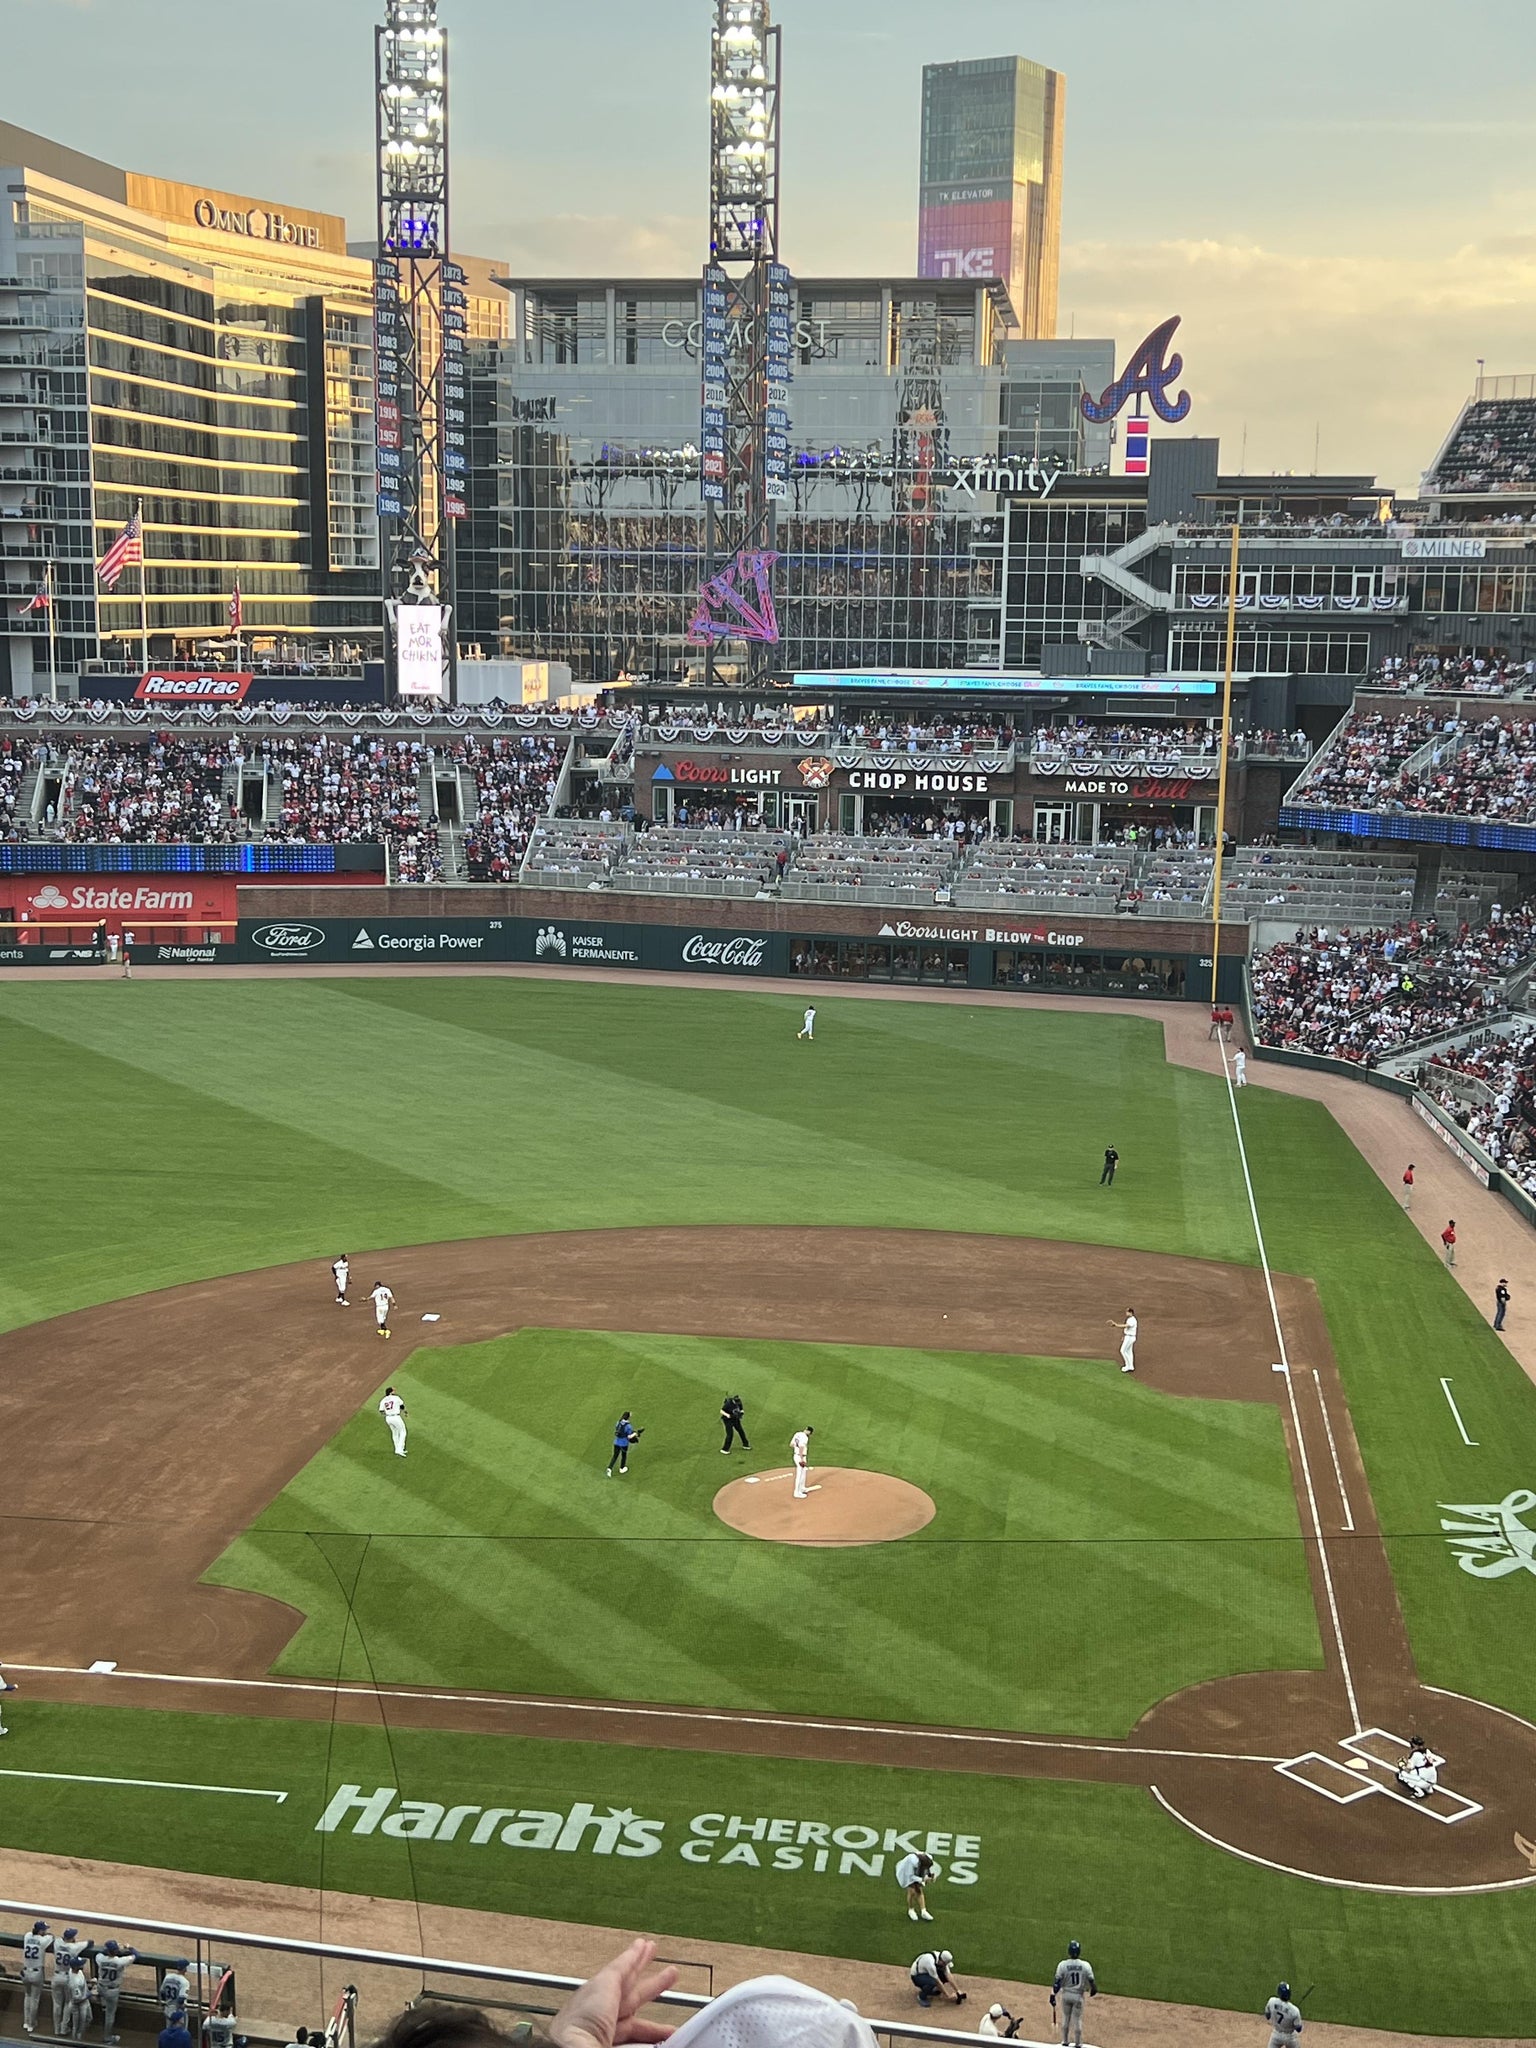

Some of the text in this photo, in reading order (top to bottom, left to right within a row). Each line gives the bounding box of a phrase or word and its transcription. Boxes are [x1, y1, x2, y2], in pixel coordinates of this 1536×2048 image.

[952, 189, 993, 200] ELEVATOR
[934, 247, 994, 278] TKE
[377, 263, 395, 278] 1872
[443, 266, 461, 279] 1873
[707, 269, 725, 282] 1996
[770, 267, 787, 280] 1997
[377, 287, 395, 301] 1874
[444, 290, 461, 303] 1875
[770, 291, 788, 305] 1999
[707, 317, 725, 330] 2000
[770, 315, 787, 329] 2001
[444, 337, 462, 351] 1891
[706, 341, 725, 354] 2002
[769, 339, 788, 353] 2003
[379, 359, 397, 373] 1892
[445, 361, 463, 375] 1893
[706, 365, 725, 378] 2004
[769, 364, 787, 377] 2005
[379, 382, 397, 394] 1897
[769, 388, 786, 400] 2012
[706, 389, 723, 401] 2010
[380, 407, 397, 420] 1914
[706, 412, 723, 425] 2013
[380, 429, 398, 443] 1957
[706, 436, 723, 449] 2019
[768, 436, 786, 449] 2020
[446, 455, 464, 468] 1982
[705, 460, 722, 473] 2021
[767, 460, 785, 473] 2022
[381, 476, 399, 490] 1991
[446, 478, 465, 492] 1992
[953, 461, 1060, 499] xfinity
[705, 485, 723, 498] 2023
[768, 481, 784, 495] 2024
[381, 499, 399, 513] 1993
[1422, 541, 1482, 556] MILNER
[410, 623, 430, 634] EAT
[408, 636, 432, 647] MOR
[402, 650, 437, 661] CHIKIN
[144, 676, 240, 694] RaceTrac
[675, 760, 782, 784] Coors LIGHT
[850, 772, 906, 789] CHOP
[915, 774, 988, 792] HOUSE
[1065, 778, 1193, 799] MADE TO Chill
[489, 921, 502, 929] 375
[265, 927, 312, 945] Ford
[896, 921, 938, 938] Coors
[940, 929, 979, 941] LIGHT
[985, 929, 1031, 943] BELOW
[1048, 932, 1084, 946] CHOP
[378, 934, 484, 951] Georgia Power
[572, 936, 604, 947] KAISER
[171, 947, 215, 957] National
[1200, 959, 1213, 967] 325
[689, 1813, 981, 1859] CHEROKEE
[25, 1946, 39, 1959] 22
[101, 1969, 117, 1981] 70
[1071, 1972, 1079, 1985] 11
[1277, 2011, 1284, 2024] 7
